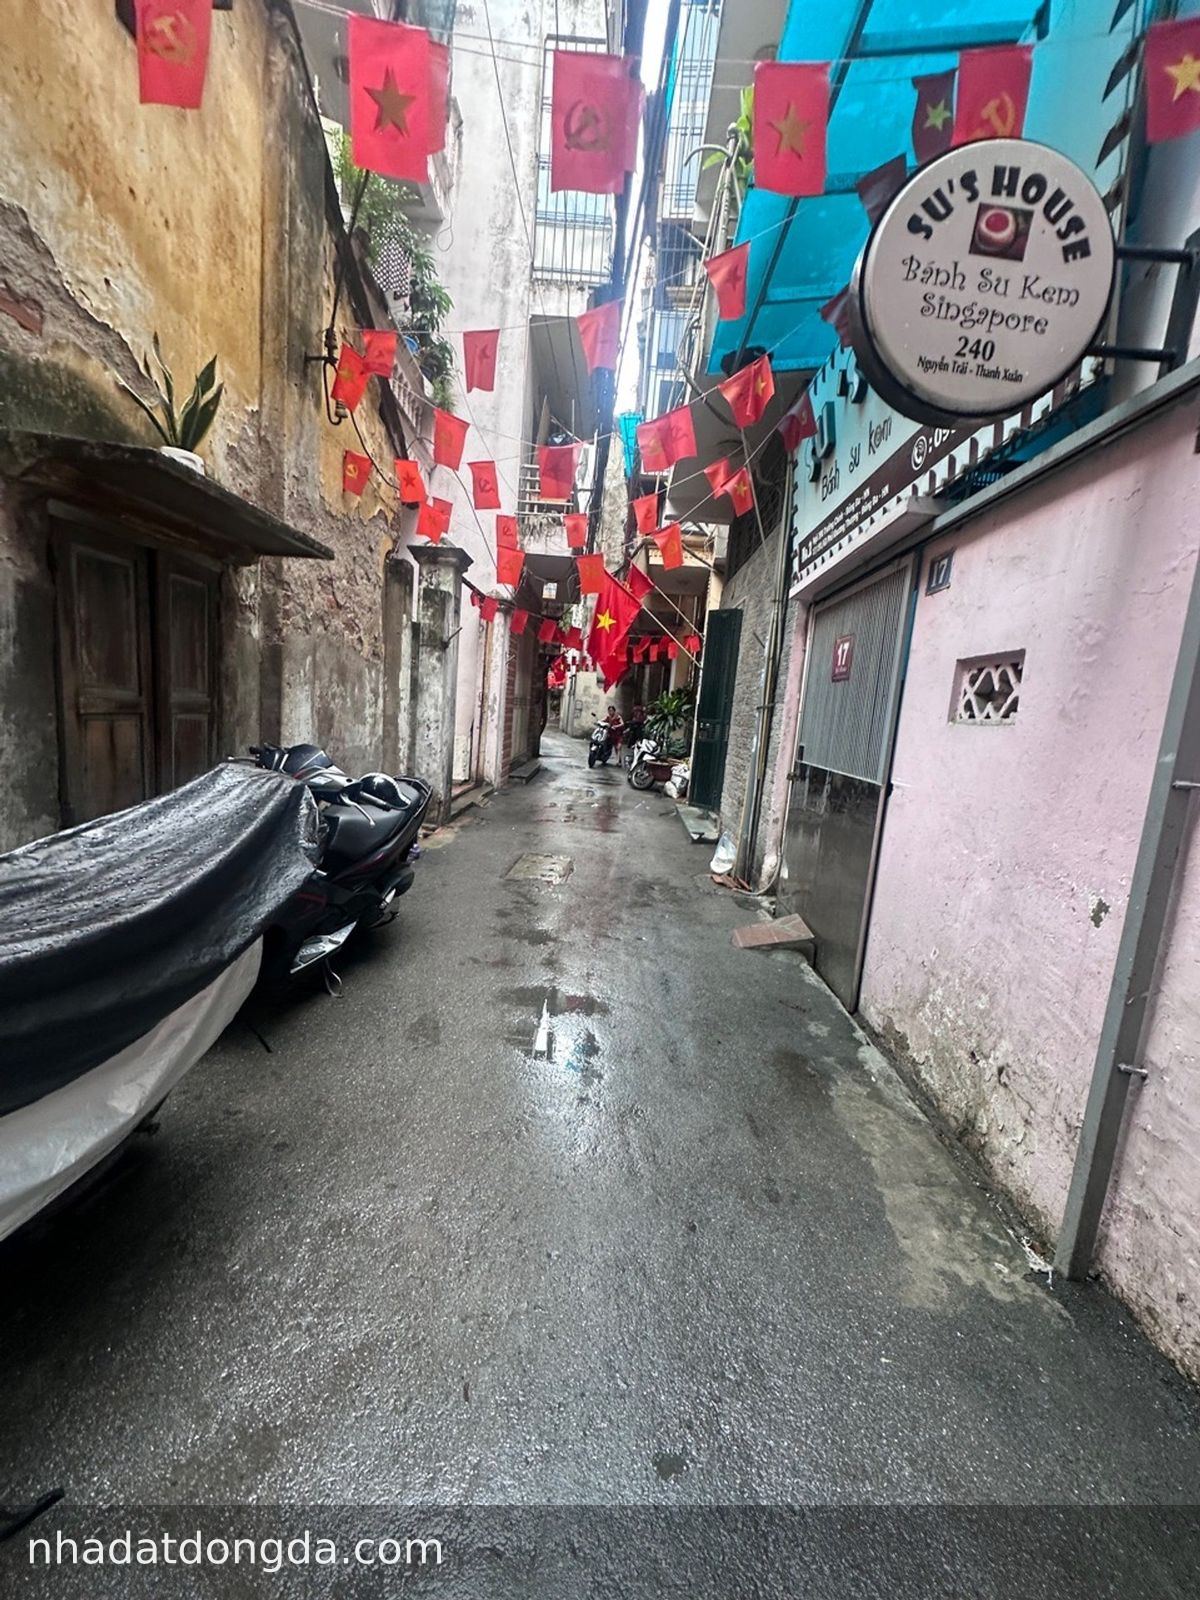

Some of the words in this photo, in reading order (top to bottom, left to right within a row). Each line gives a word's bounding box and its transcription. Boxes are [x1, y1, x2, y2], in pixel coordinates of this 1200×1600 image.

[907, 170, 980, 240] SU'S
[991, 165, 1091, 264] HOUSE
[902, 255, 966, 291] Bánh
[977, 268, 1009, 297] Su
[1020, 275, 1080, 308] Kem
[920, 292, 1049, 335] Singapore
[955, 336, 995, 362] 240
[975, 364, 1001, 380] Thanh
[930, 558, 948, 588] 17
[837, 641, 850, 667] 17
